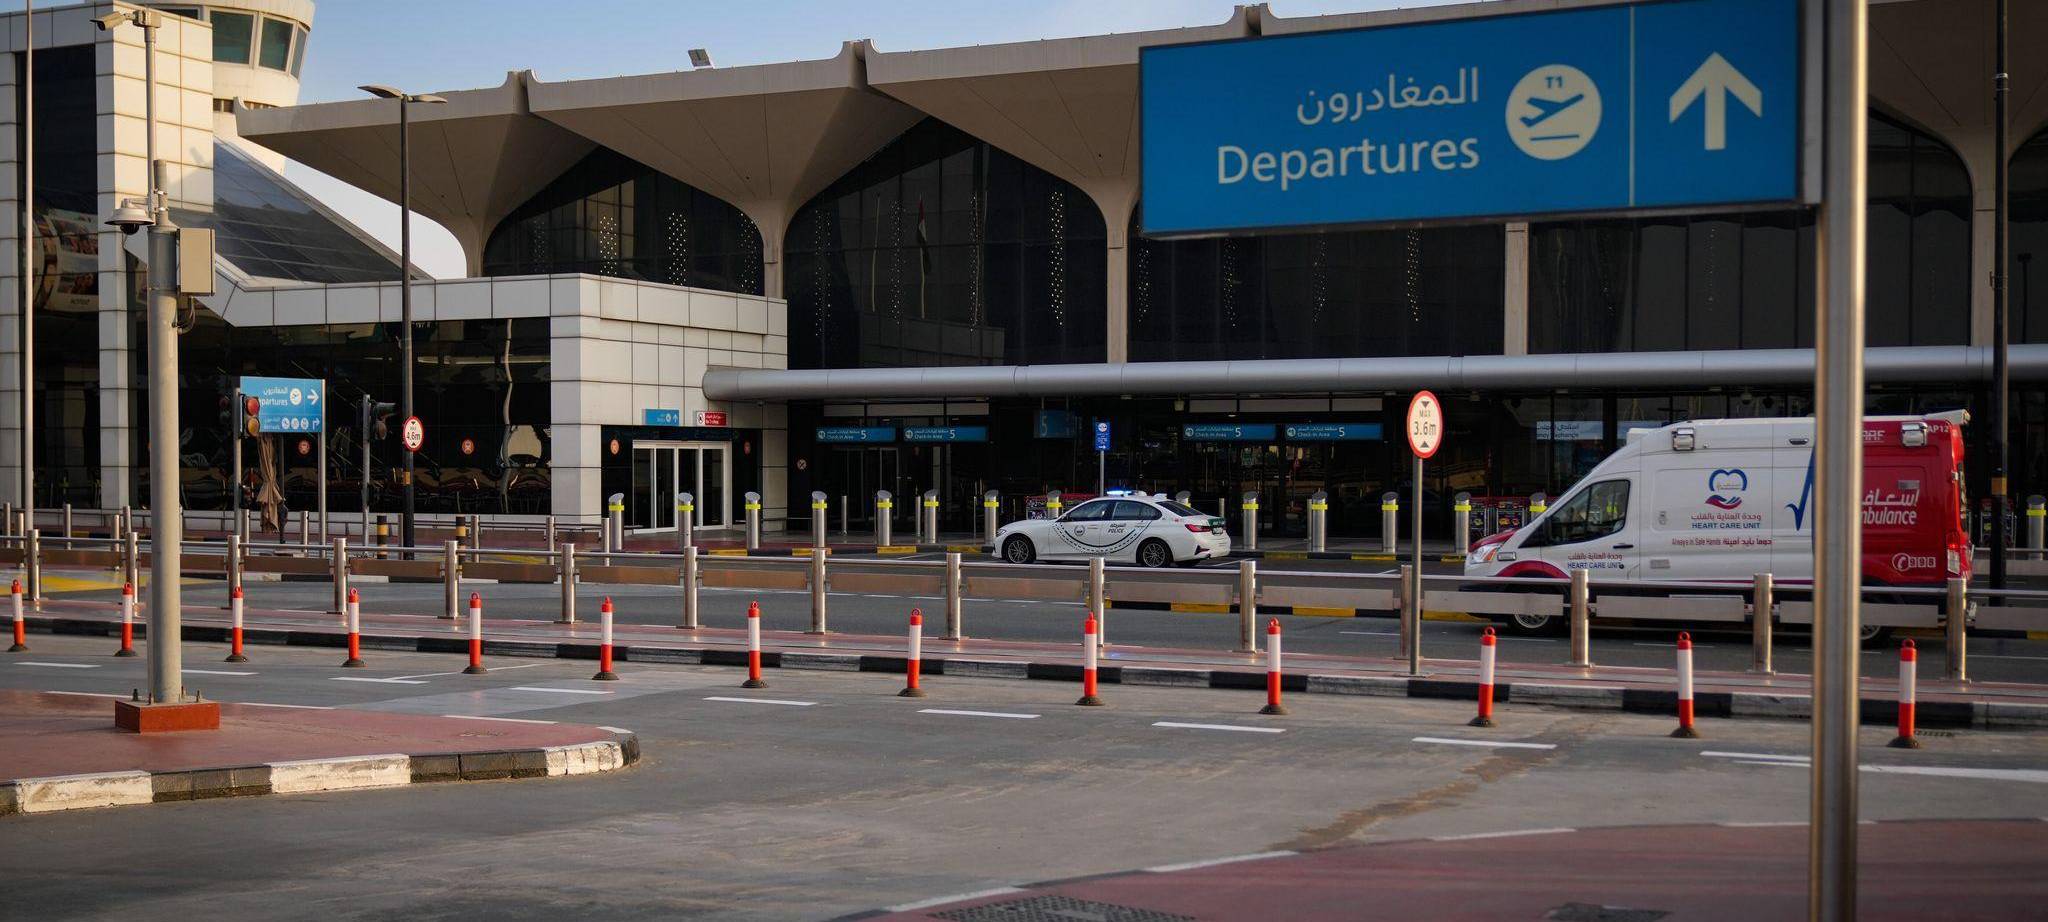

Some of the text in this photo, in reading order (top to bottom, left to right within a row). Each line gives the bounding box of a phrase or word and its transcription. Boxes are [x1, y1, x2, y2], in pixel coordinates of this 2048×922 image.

[1544, 76, 1563, 89] T1
[1296, 66, 1479, 126] المغادرون
[1217, 137, 1480, 191] Departures
[860, 429, 867, 440] 5
[949, 429, 956, 439] 5
[1235, 427, 1241, 437] 5
[1338, 426, 1345, 437] 5
[1413, 421, 1437, 436] 3.6m
